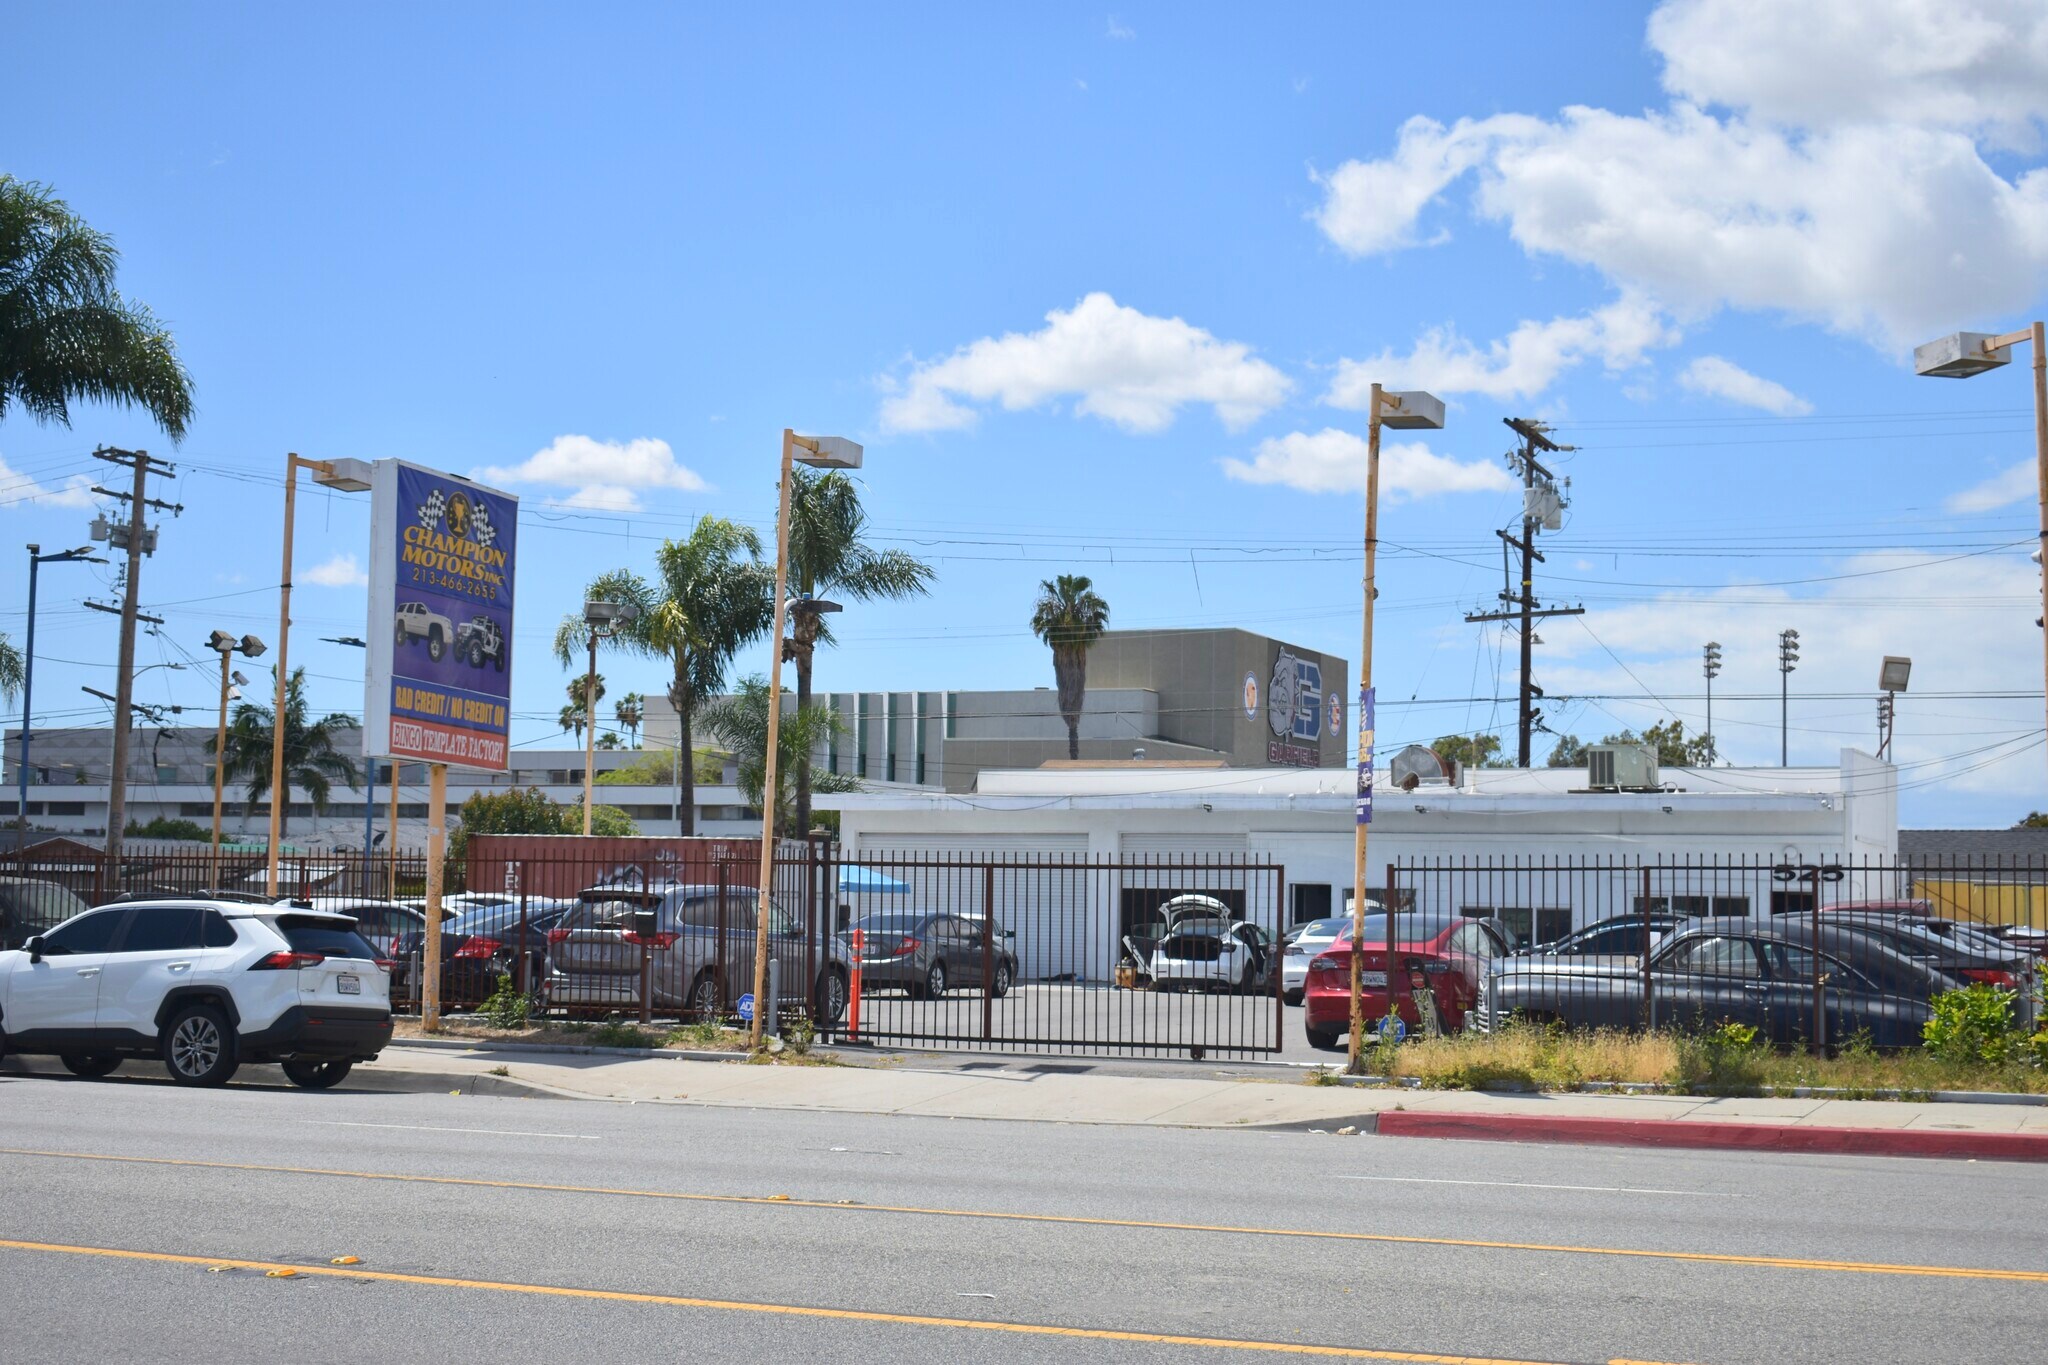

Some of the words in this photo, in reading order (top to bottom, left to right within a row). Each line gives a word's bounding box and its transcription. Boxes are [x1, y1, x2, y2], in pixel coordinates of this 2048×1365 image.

[402, 543, 485, 581] MOTORS
[484, 571, 505, 586] INC
[403, 526, 507, 568] CHAMPION
[412, 567, 496, 600] 213-466-2655
[395, 685, 413, 710] BAD
[414, 689, 446, 716] CREDIT
[450, 696, 463, 719] NO
[463, 699, 494, 725] CREDIT
[392, 723, 422, 751] BINGO
[422, 729, 467, 757] TEMPLATE
[467, 736, 505, 763] FACTORY
[1268, 740, 1320, 768] GARFIELD
[1773, 864, 1845, 882] 525
